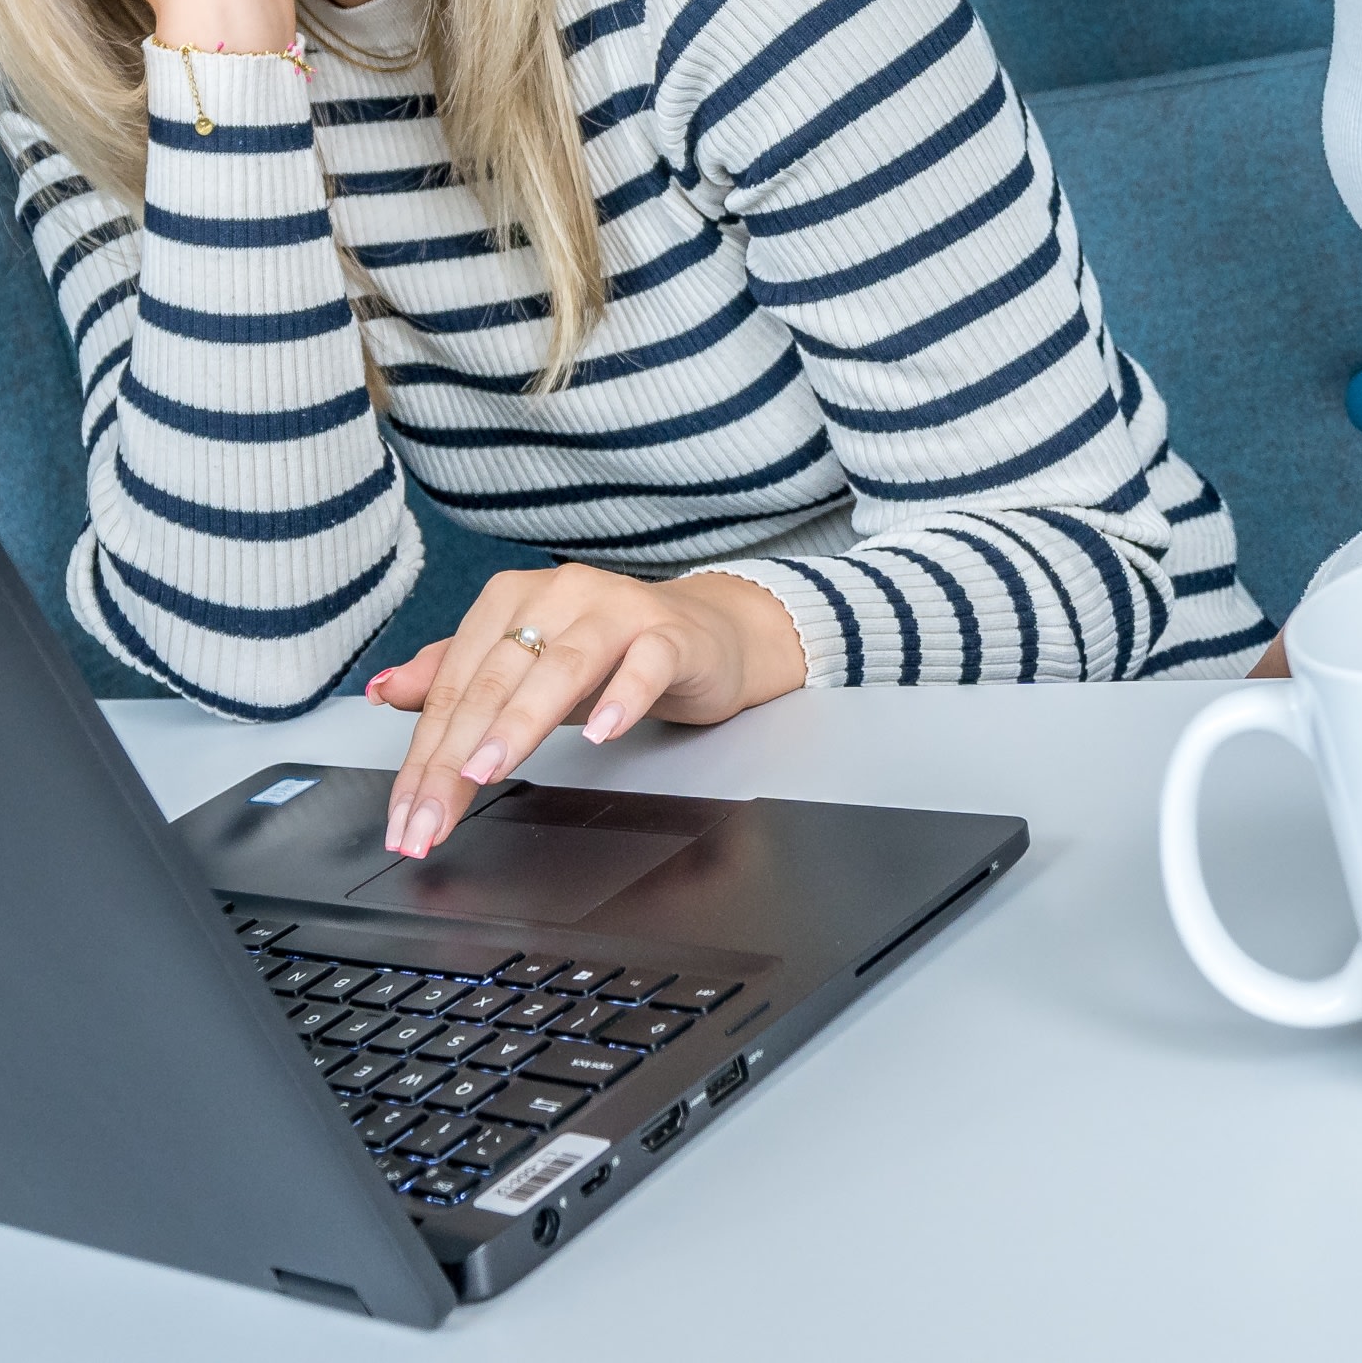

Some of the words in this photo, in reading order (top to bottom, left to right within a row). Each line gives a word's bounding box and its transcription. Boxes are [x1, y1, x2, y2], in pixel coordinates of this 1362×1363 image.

[288, 972, 306, 981] N
[334, 979, 350, 987] B
[377, 985, 393, 994] V
[426, 991, 441, 1000] C
[473, 997, 492, 1007] X
[523, 1005, 543, 1015] Z
[304, 1015, 320, 1024] G
[350, 1022, 367, 1031] F
[399, 1029, 416, 1038] D
[447, 1036, 465, 1046] S
[501, 1044, 517, 1054] A
[354, 1066, 372, 1076] E
[399, 1074, 422, 1086] W
[456, 1082, 473, 1094] Q
